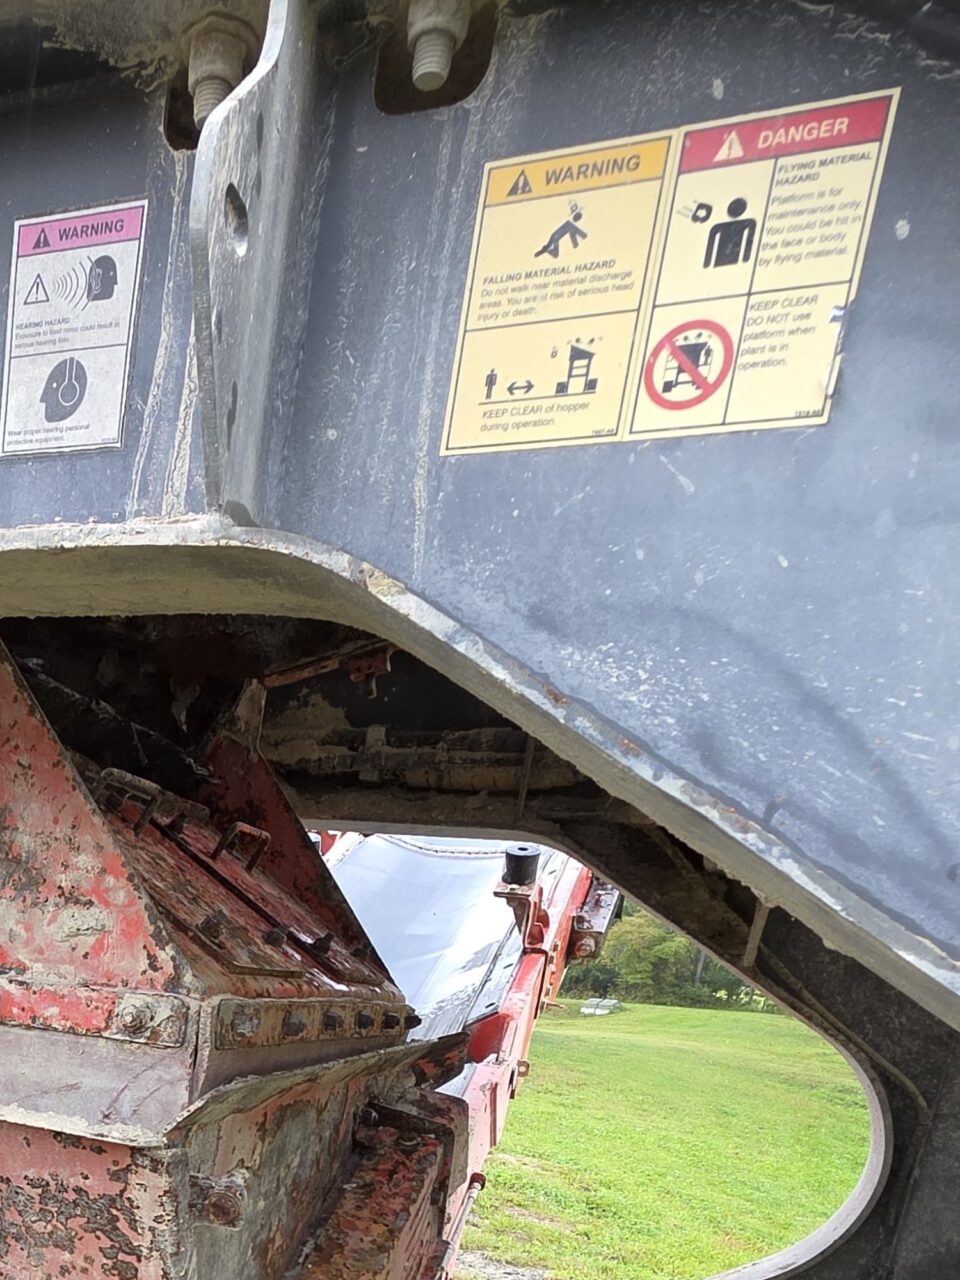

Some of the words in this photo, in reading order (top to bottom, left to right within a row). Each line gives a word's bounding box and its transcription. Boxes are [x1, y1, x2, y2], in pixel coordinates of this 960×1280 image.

[757, 117, 849, 149] DANGER
[544, 154, 641, 186] WARNING
[778, 160, 816, 174] FLYING
[818, 151, 872, 168] MATERIAL
[775, 172, 820, 188] HAZARD
[771, 191, 814, 206] Platform
[817, 190, 826, 199] is
[829, 186, 844, 197] for
[768, 204, 836, 221] maintenance
[58, 218, 125, 242] WARNING
[766, 225, 784, 236] You
[787, 220, 817, 232] could
[818, 218, 833, 227] be
[835, 215, 849, 226] hit
[851, 214, 862, 223] in
[761, 241, 778, 252] the
[781, 237, 803, 248] face
[805, 235, 817, 245] or
[818, 232, 847, 243] body
[758, 257, 773, 268] by
[774, 252, 802, 265] flying
[483, 272, 522, 286] FALLING
[524, 266, 572, 280] MATERIAL
[575, 259, 616, 272] HAZARD
[481, 288, 493, 299] Do
[495, 285, 508, 296] not
[510, 283, 529, 294] walk
[531, 282, 551, 291] near
[552, 276, 587, 288] material
[589, 271, 633, 284] discharge
[507, 295, 522, 306] You
[524, 294, 538, 303] are
[550, 291, 565, 300] risk
[566, 288, 576, 299] of
[577, 286, 609, 297] serious
[611, 282, 634, 292] head
[749, 300, 779, 312] KEEP
[781, 295, 819, 309] CLEAR
[477, 309, 500, 322] injury
[501, 308, 510, 317] or
[746, 316, 764, 327] DO
[765, 312, 791, 325] NOT
[792, 312, 812, 322] use
[15, 321, 44, 331] HEARING
[45, 317, 71, 327] HAZARD
[743, 328, 785, 343] platform
[788, 326, 816, 337] when
[740, 344, 767, 358] plant
[768, 344, 777, 353] is
[779, 343, 789, 352] in
[482, 408, 509, 419] KEEP
[510, 405, 543, 417] CLEAR
[544, 403, 555, 414] of
[556, 402, 590, 413] hopper
[480, 421, 509, 433] during
